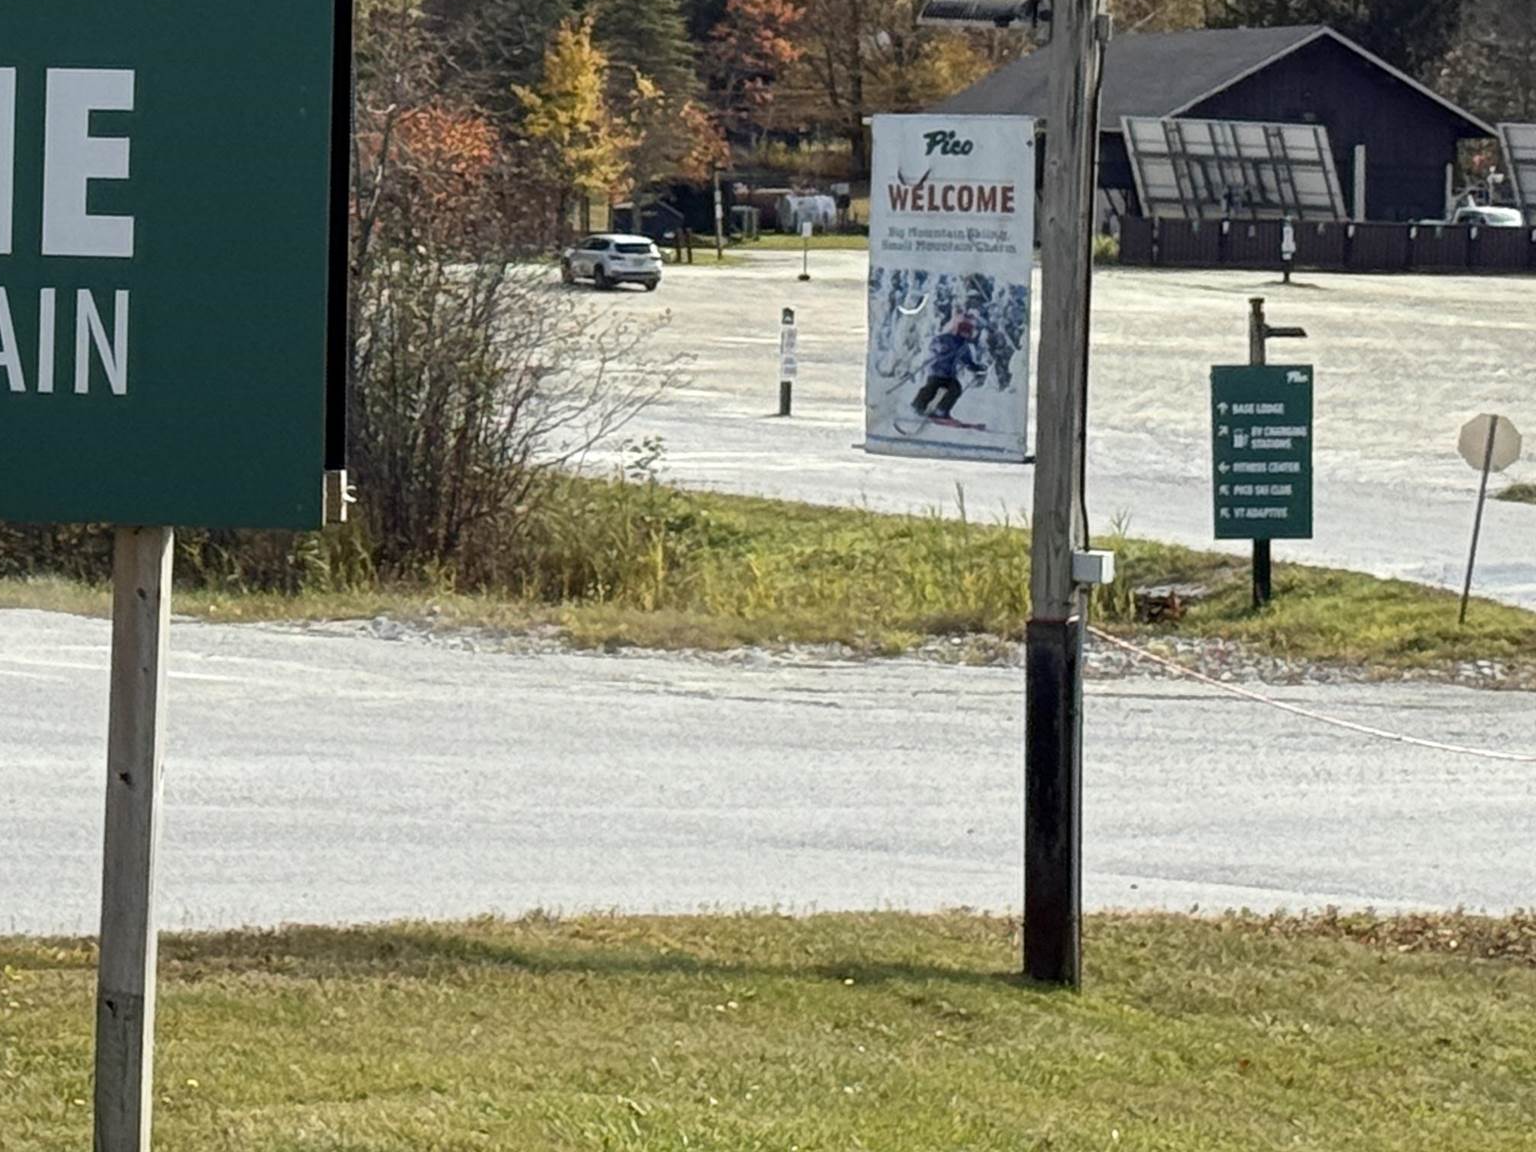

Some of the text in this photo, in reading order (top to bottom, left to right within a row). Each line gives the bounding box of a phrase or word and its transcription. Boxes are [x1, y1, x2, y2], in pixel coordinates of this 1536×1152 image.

[923, 130, 973, 156] Pico
[888, 184, 1015, 214] WELCOME
[908, 227, 965, 239] Mountain
[915, 240, 973, 252] Mountain
[1232, 403, 1284, 415] BASE LODGE
[1251, 426, 1263, 437] EV
[1268, 461, 1300, 473] CENTER
[1233, 484, 1253, 496] PICO
